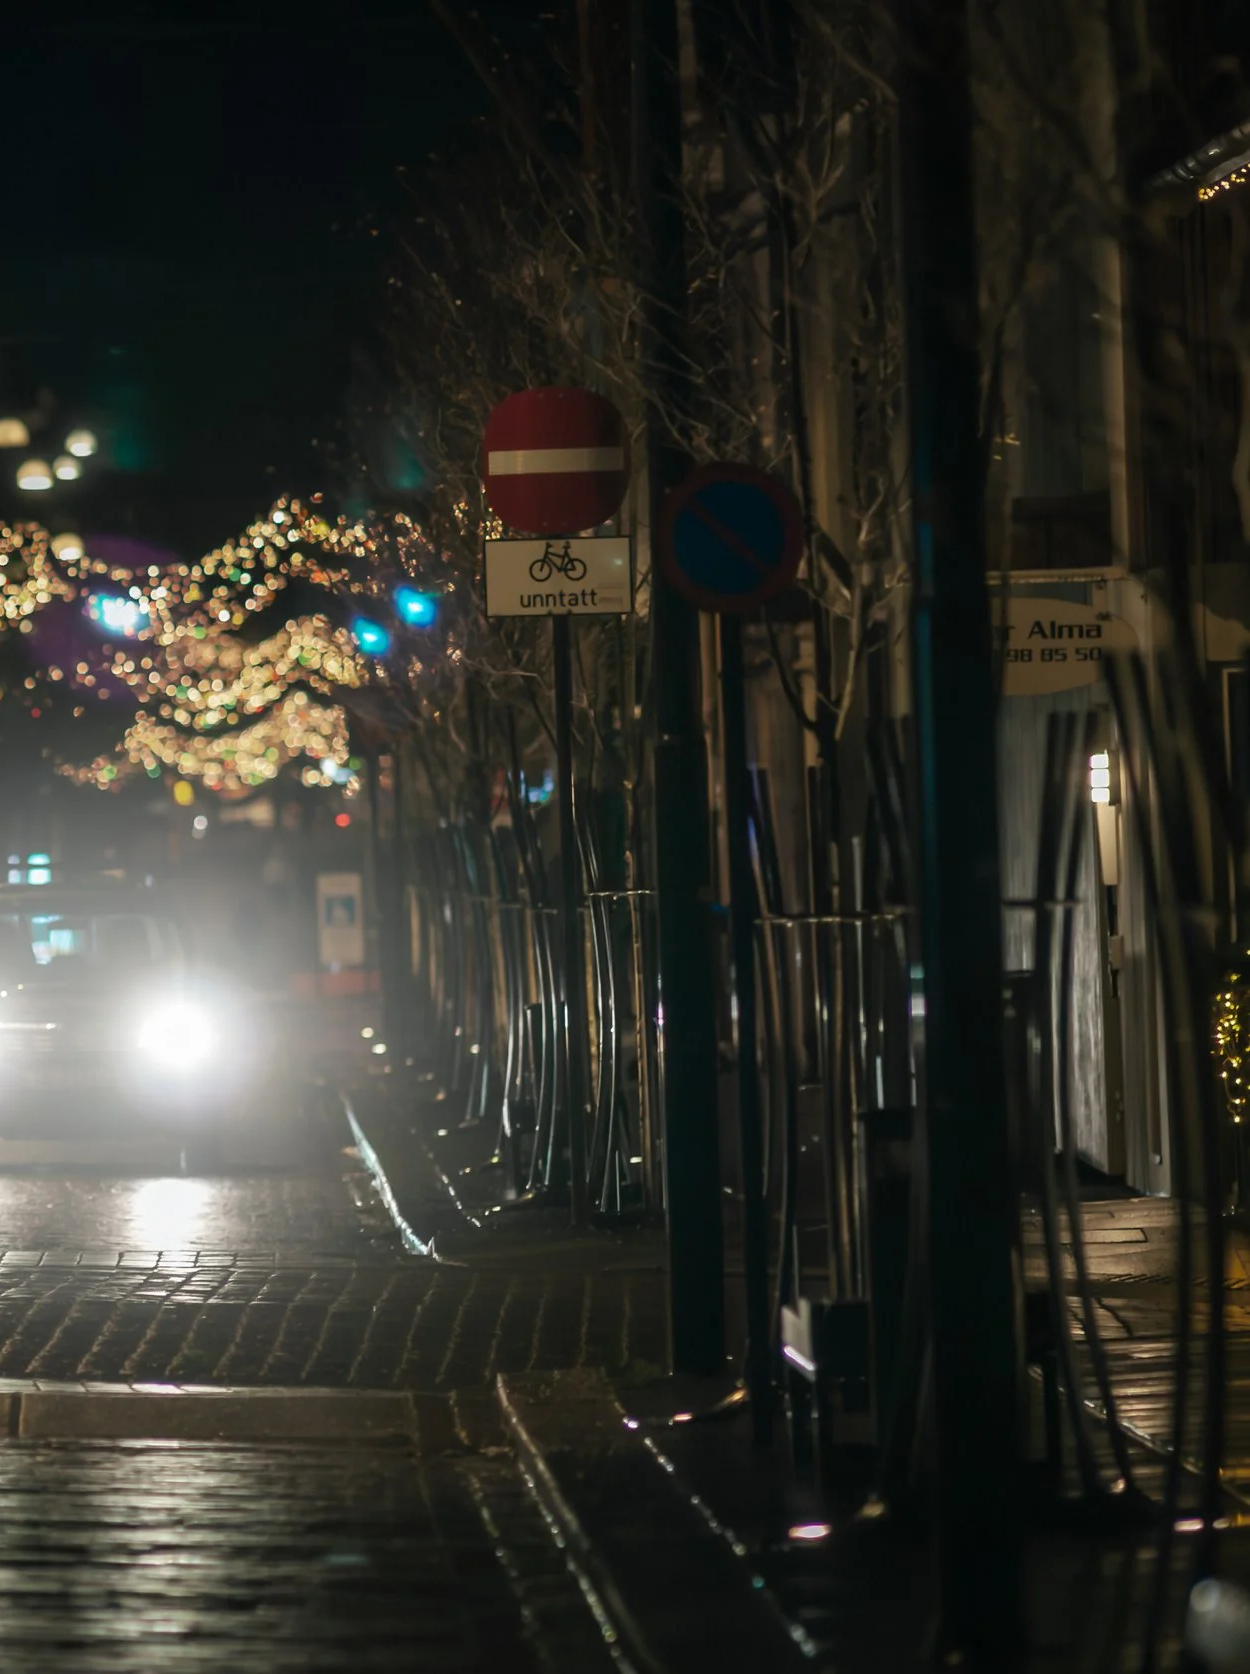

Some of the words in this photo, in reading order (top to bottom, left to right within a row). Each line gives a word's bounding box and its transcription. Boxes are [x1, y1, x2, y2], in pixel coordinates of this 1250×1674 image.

[520, 588, 598, 608] unntatt
[1027, 619, 1103, 640] Alma
[1005, 648, 1033, 663] 98
[1040, 647, 1068, 662] 85
[1075, 646, 1103, 662] 50
